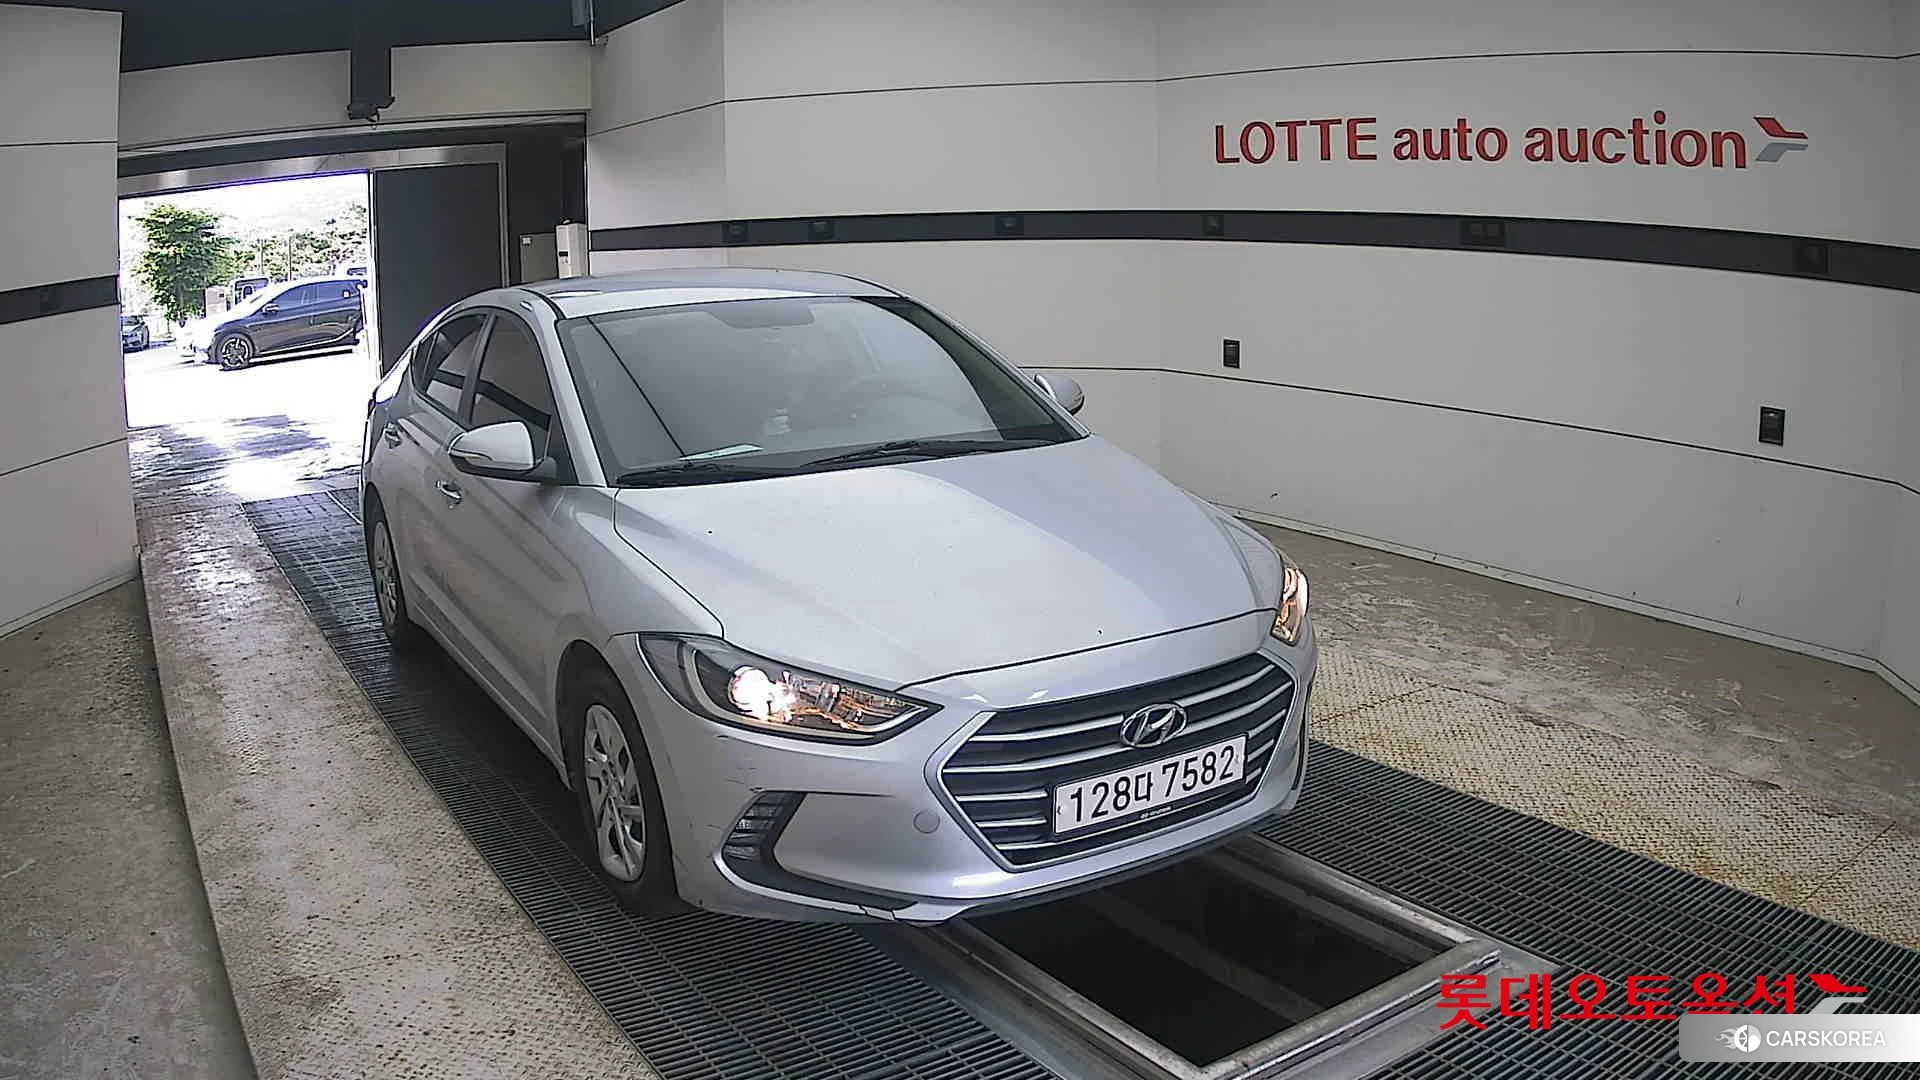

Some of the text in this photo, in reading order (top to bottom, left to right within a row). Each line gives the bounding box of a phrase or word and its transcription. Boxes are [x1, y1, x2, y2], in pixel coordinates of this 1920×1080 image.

[1215, 110, 1748, 168] LOTTE auto auction
[1161, 745, 1234, 798] 7582
